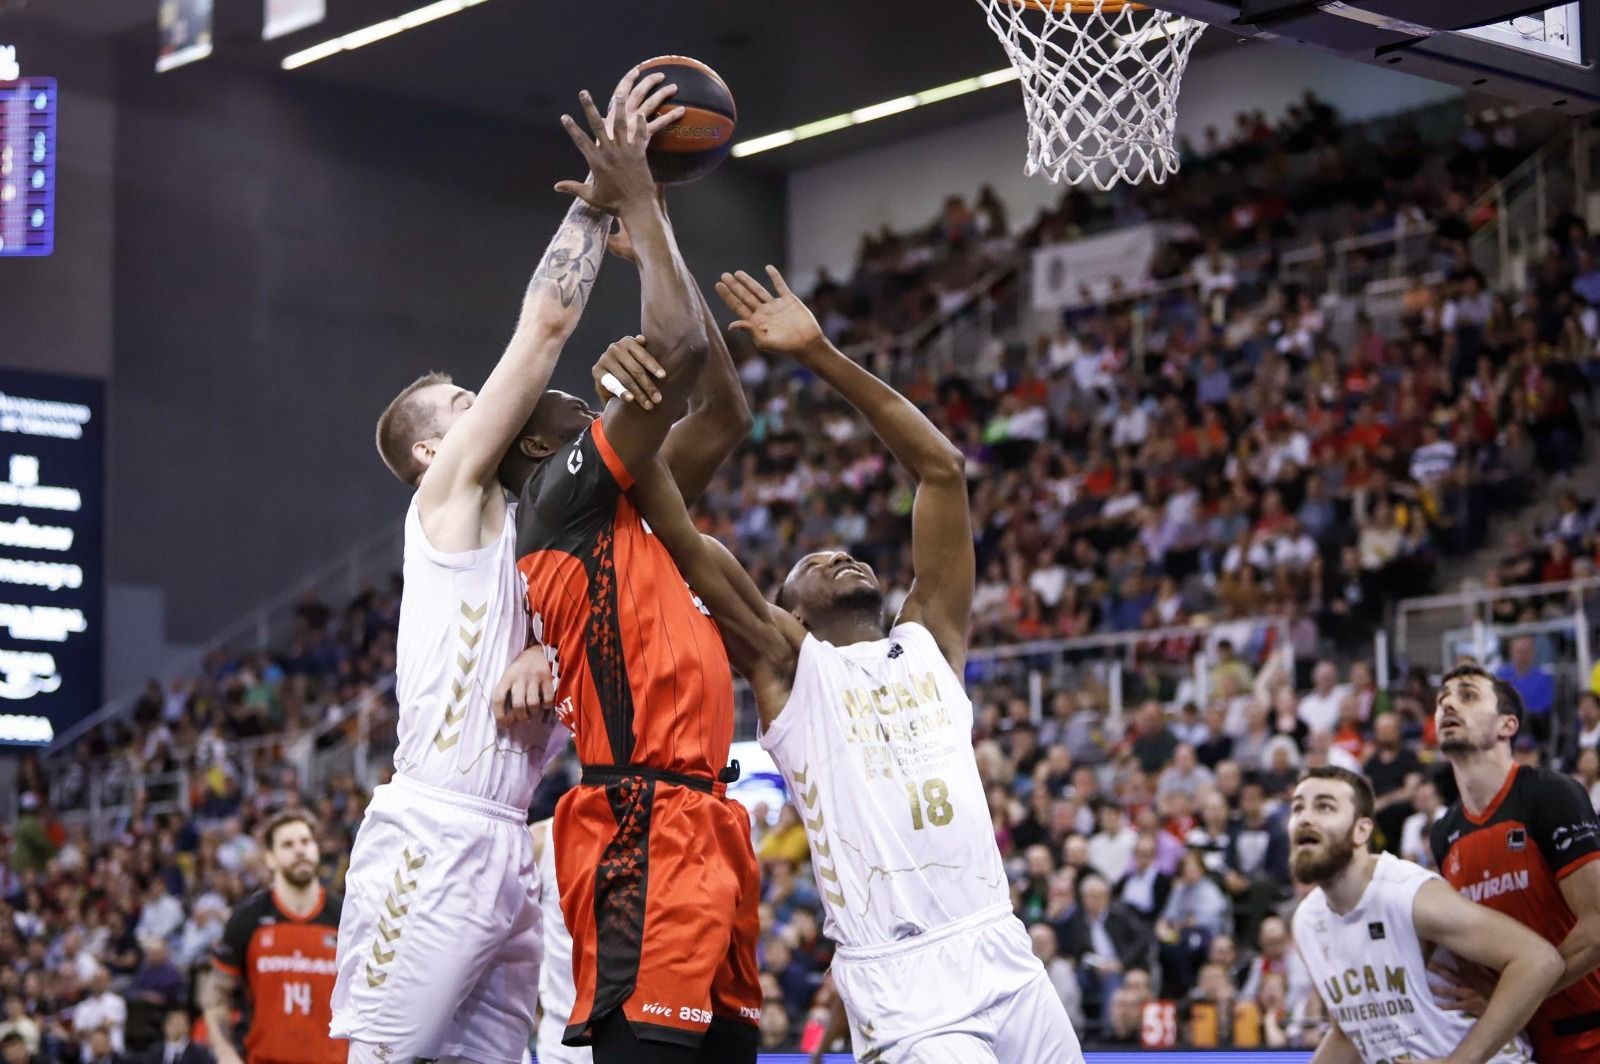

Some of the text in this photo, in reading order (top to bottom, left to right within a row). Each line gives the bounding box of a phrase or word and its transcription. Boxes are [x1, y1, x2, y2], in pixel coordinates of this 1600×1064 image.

[905, 778, 954, 830] 18
[283, 981, 311, 1014] 14
[1324, 965, 1407, 1004] UCAM
